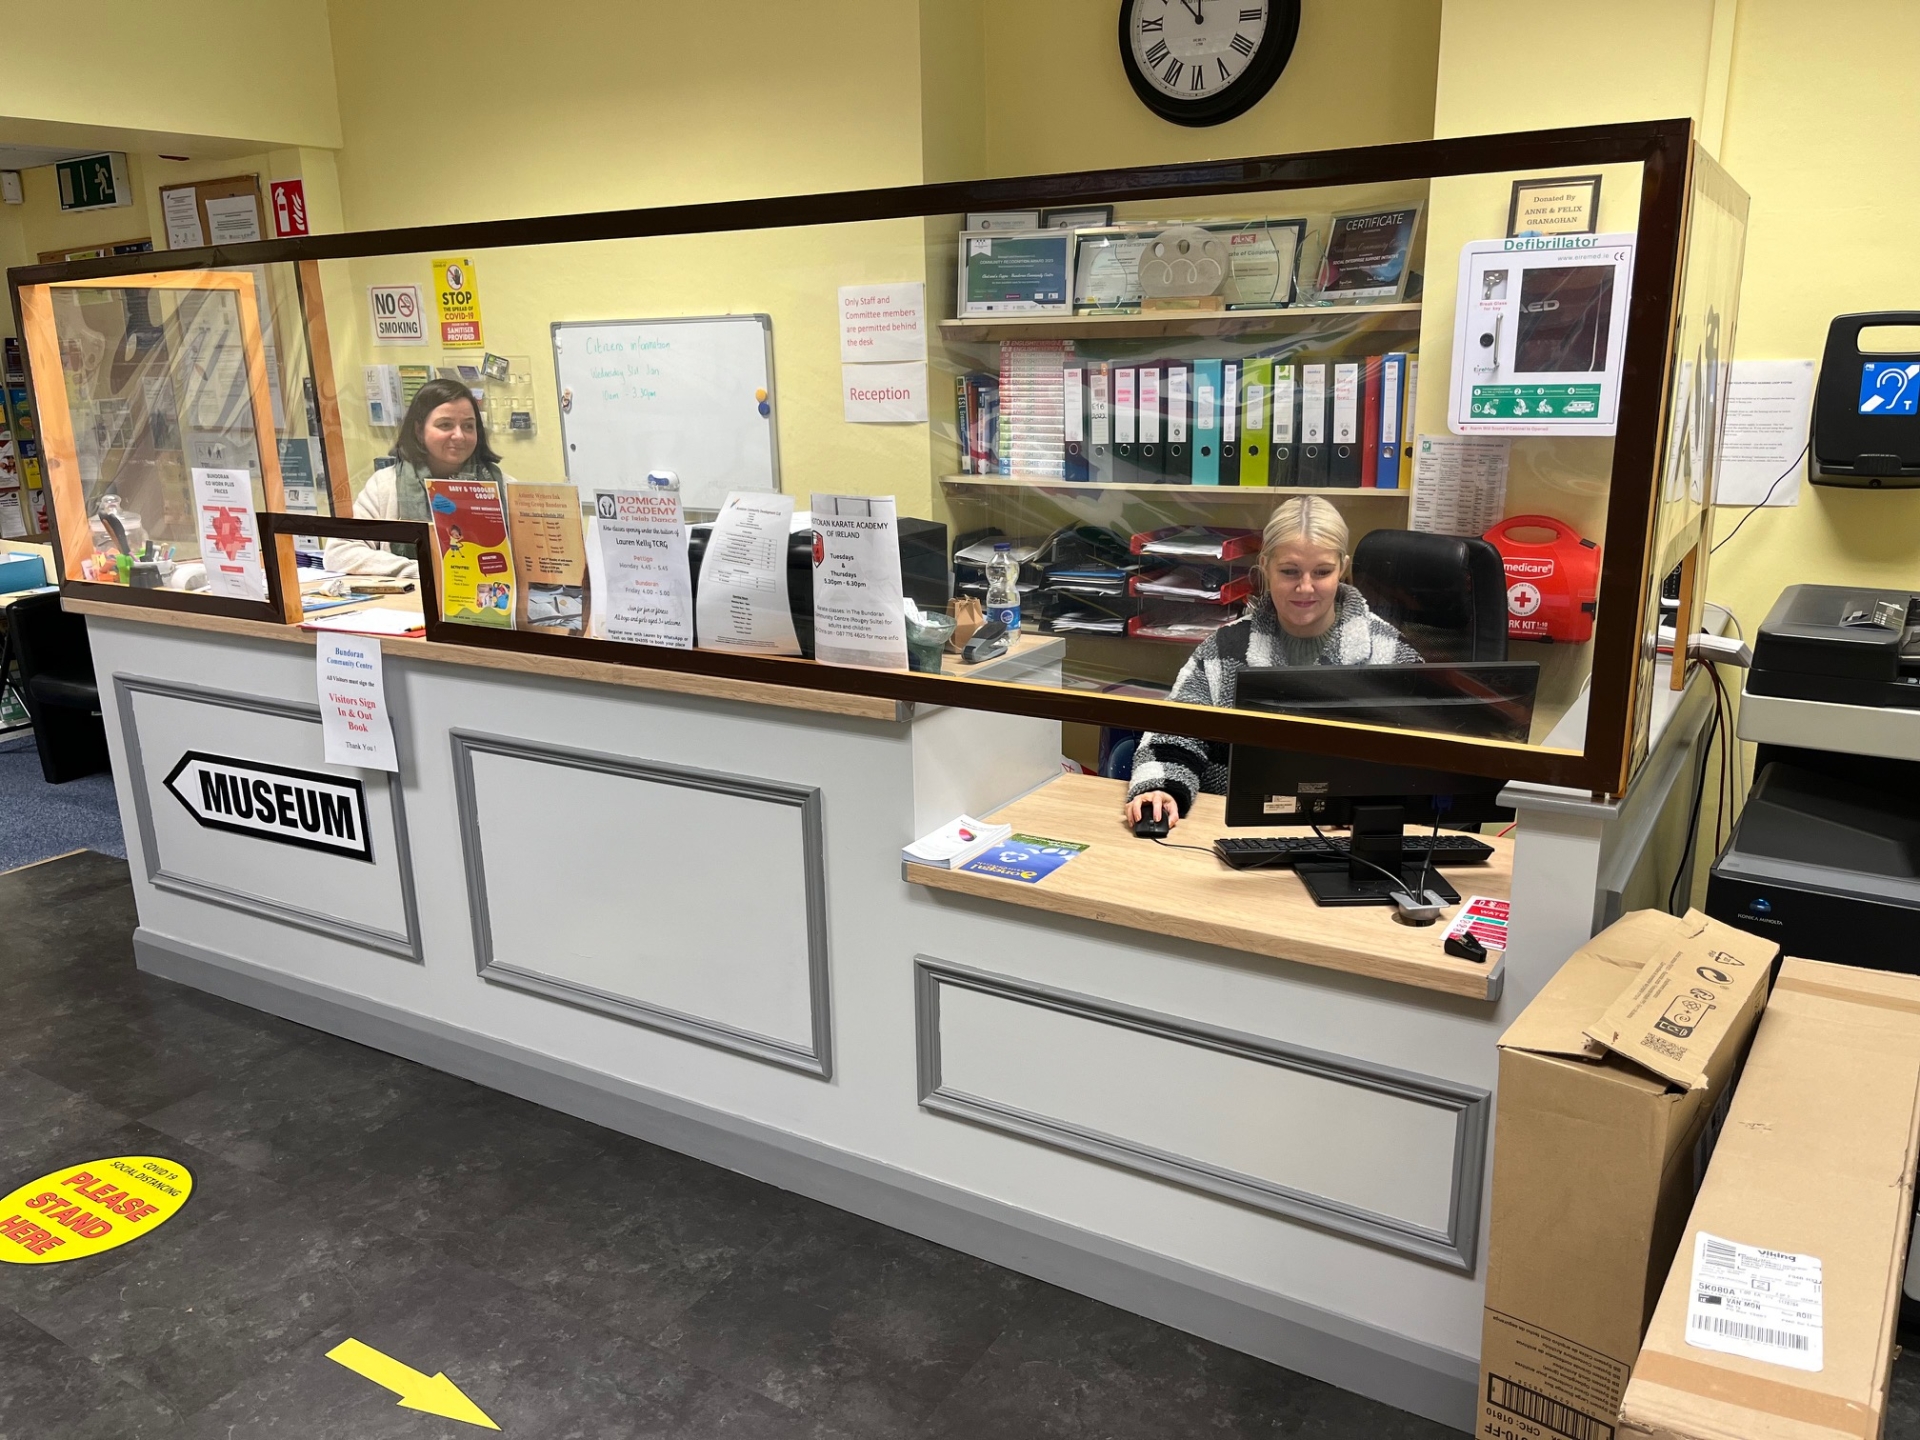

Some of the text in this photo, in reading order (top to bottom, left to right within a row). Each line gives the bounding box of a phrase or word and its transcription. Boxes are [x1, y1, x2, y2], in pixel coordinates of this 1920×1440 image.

[1534, 195, 1564, 203] Donated
[1346, 213, 1404, 231] CERTIFICATE
[1527, 217, 1577, 225] GRANAGHAN
[1504, 237, 1598, 251] Defibrillator
[1558, 253, 1609, 261] www.eiremed.ie
[442, 291, 472, 305] STOP
[845, 296, 890, 307] Only Staff and
[375, 293, 396, 315] NO
[445, 312, 474, 320] COVID-19
[846, 309, 915, 319] Committee members
[380, 322, 417, 334] SMOKING
[858, 323, 890, 333] permitted
[892, 322, 916, 331] behind
[448, 333, 475, 341] PROVIDED
[859, 338, 873, 346] desk
[590, 368, 625, 387] Wednesday
[850, 387, 910, 403] Reception
[1904, 400, 1912, 411] T
[469, 486, 495, 494] TODDLER
[617, 496, 676, 506] DOMICAN
[619, 506, 676, 515] ACADEMY
[831, 520, 854, 529] KARATE
[856, 522, 888, 530] ACADEMY
[616, 538, 635, 546] Lauren
[636, 540, 651, 549] Kelly
[634, 555, 653, 563] Pettigo
[830, 553, 854, 561] Tuesdays
[619, 562, 638, 570] Monday
[830, 570, 857, 578] Thursdays
[824, 578, 866, 588] 5.30pm 6.30pm
[625, 587, 640, 595] Friday
[834, 614, 849, 622] Centre
[852, 624, 871, 632] children
[1509, 620, 1520, 628] RK
[1523, 621, 1536, 629] KIT
[335, 648, 364, 659] Bundoran
[327, 657, 373, 670] Community Centre
[329, 693, 376, 710] Visitors Sign
[338, 707, 373, 720] In & Out
[348, 722, 368, 732] Book
[346, 741, 373, 752] Thank You
[198, 769, 357, 841] MUSEUM
[1737, 913, 1758, 921] KONICA
[143, 1162, 178, 1180] COVID 19
[110, 1161, 182, 1197] SOCIAL DISTANCING
[61, 1171, 160, 1223] PLEASE
[25, 1192, 113, 1239] STAND
[0, 1215, 66, 1256] HERE
[1758, 1250, 1796, 1262] Viking
[1726, 1298, 1742, 1306] VAN
[1486, 1408, 1540, 1436] CRC: 01810
